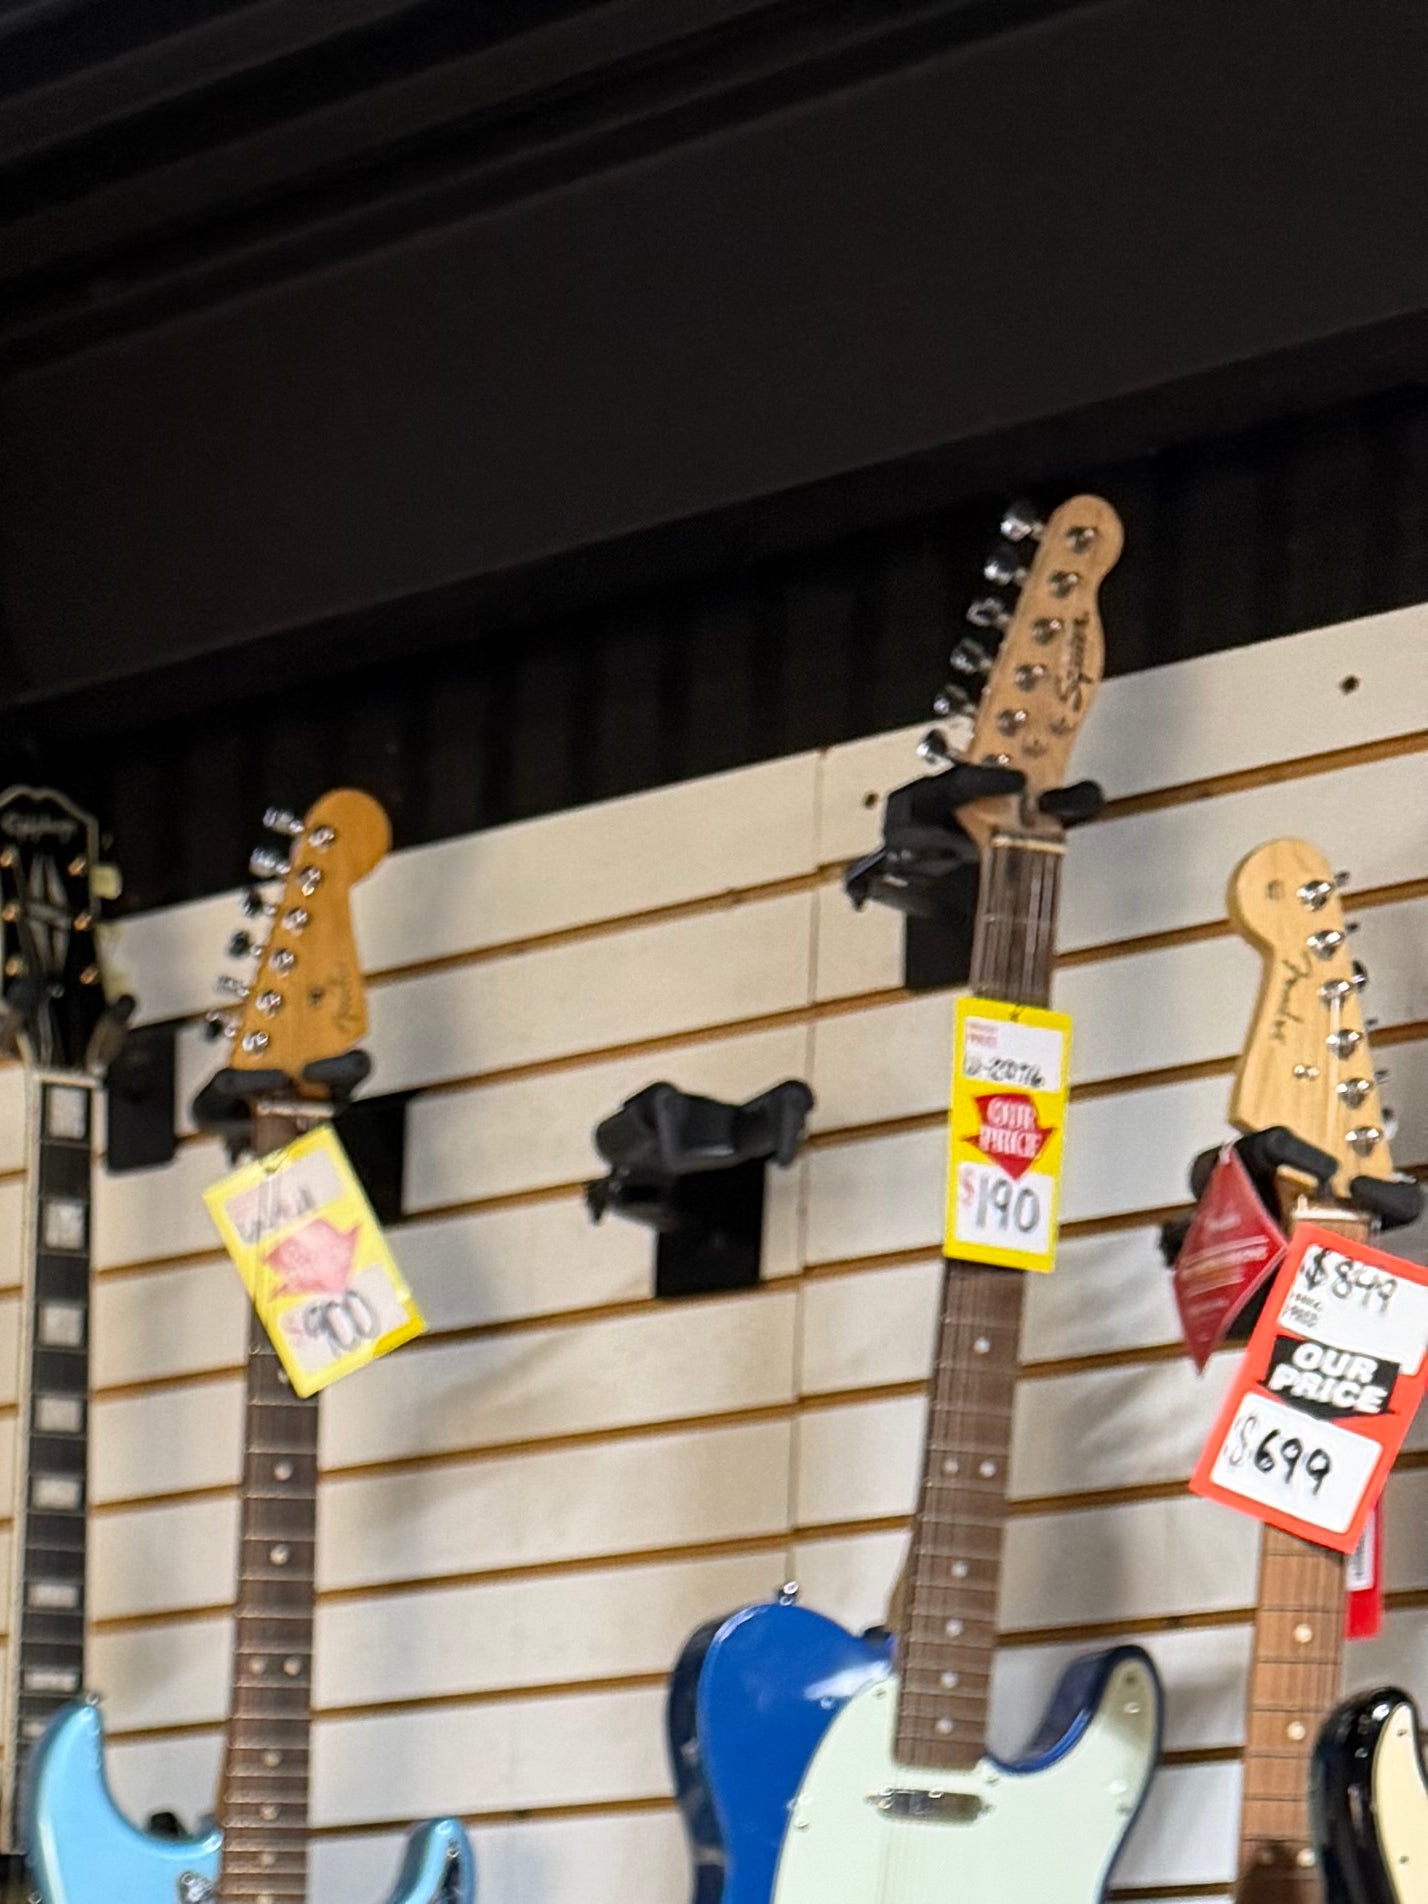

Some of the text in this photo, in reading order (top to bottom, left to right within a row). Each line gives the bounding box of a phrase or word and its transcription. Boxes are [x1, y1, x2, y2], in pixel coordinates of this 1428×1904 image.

[986, 1096, 1037, 1132] OUR
[979, 1124, 1043, 1158] PRICE
[1292, 1342, 1378, 1384] OUR
[1267, 1363, 1390, 1414] PRICE
